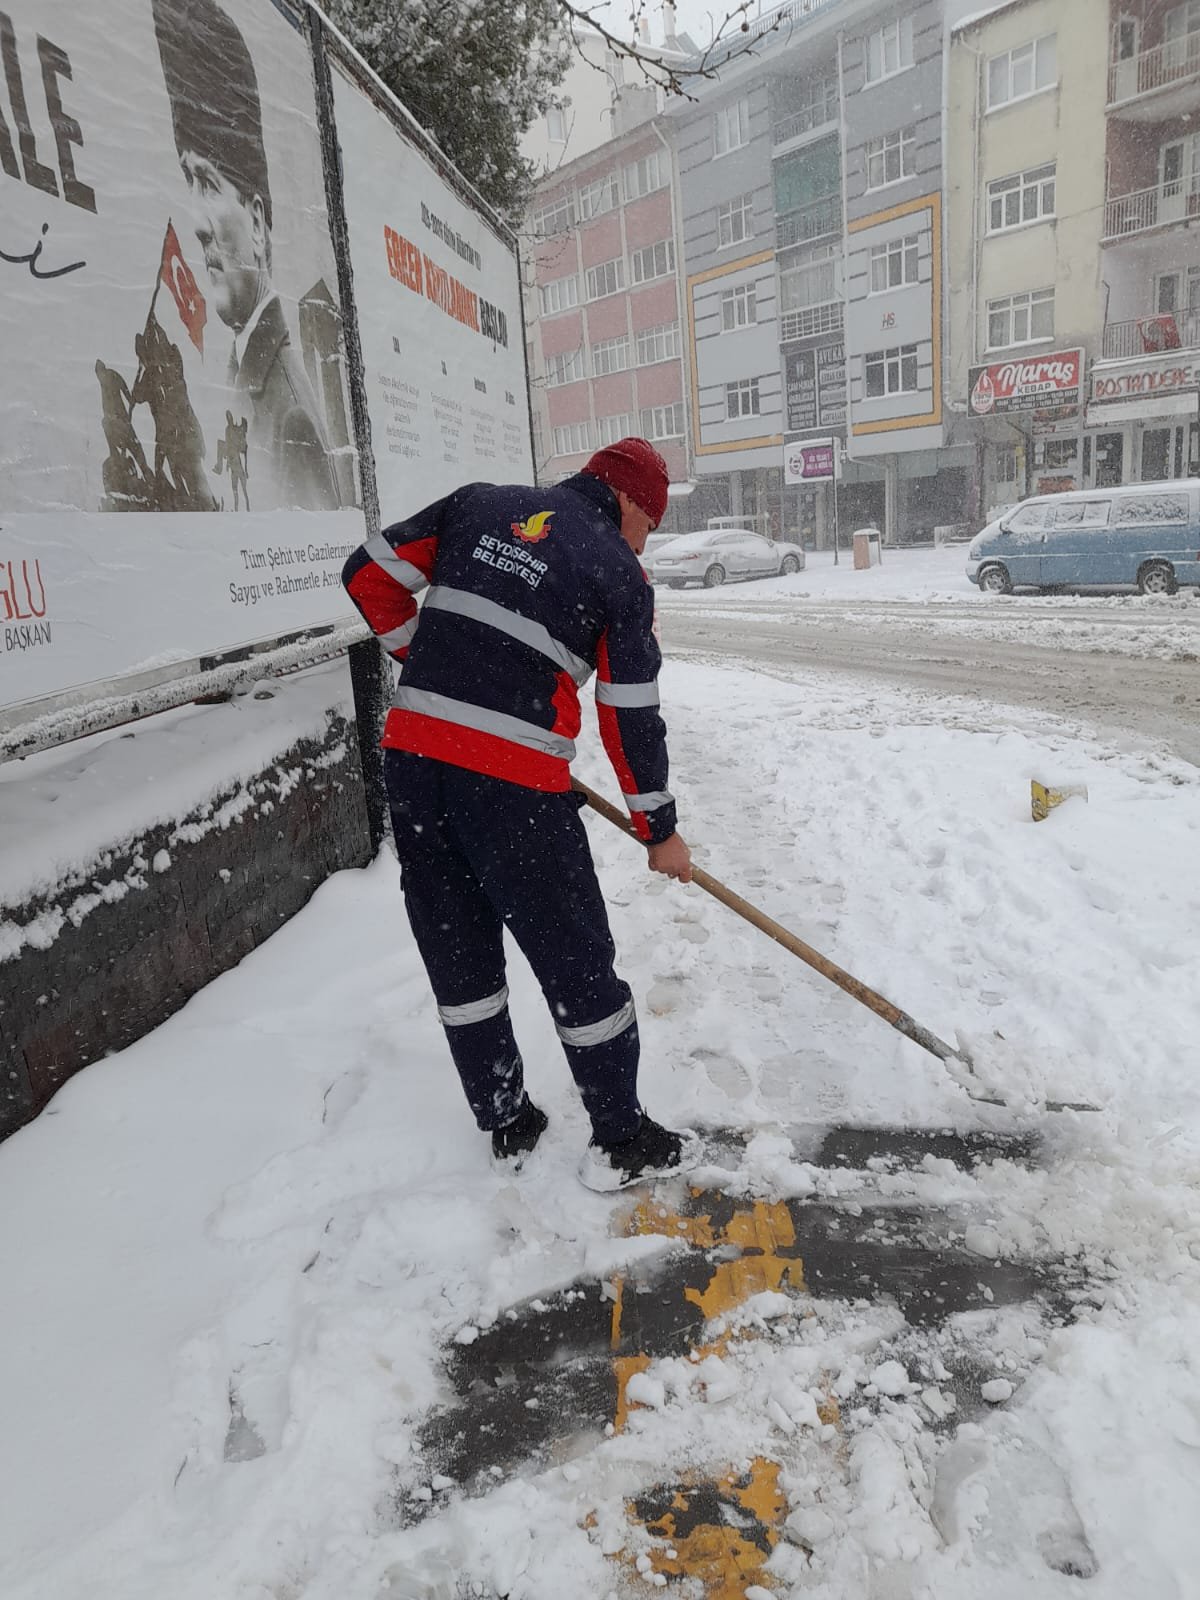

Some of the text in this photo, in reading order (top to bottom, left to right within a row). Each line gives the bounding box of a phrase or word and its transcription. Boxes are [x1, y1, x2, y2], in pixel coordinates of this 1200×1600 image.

[996, 361, 1074, 392] Maraş
[1017, 382, 1052, 395] KEBAP
[240, 548, 267, 570] Tüm
[267, 546, 296, 571] Şehit
[295, 549, 306, 563] ve
[472, 547, 542, 588] BELEDİYESİ
[479, 534, 549, 575] SEYDİŞEHİR
[229, 582, 261, 606] Saygı
[261, 581, 275, 597] ve
[275, 571, 321, 595] Rahmetle
